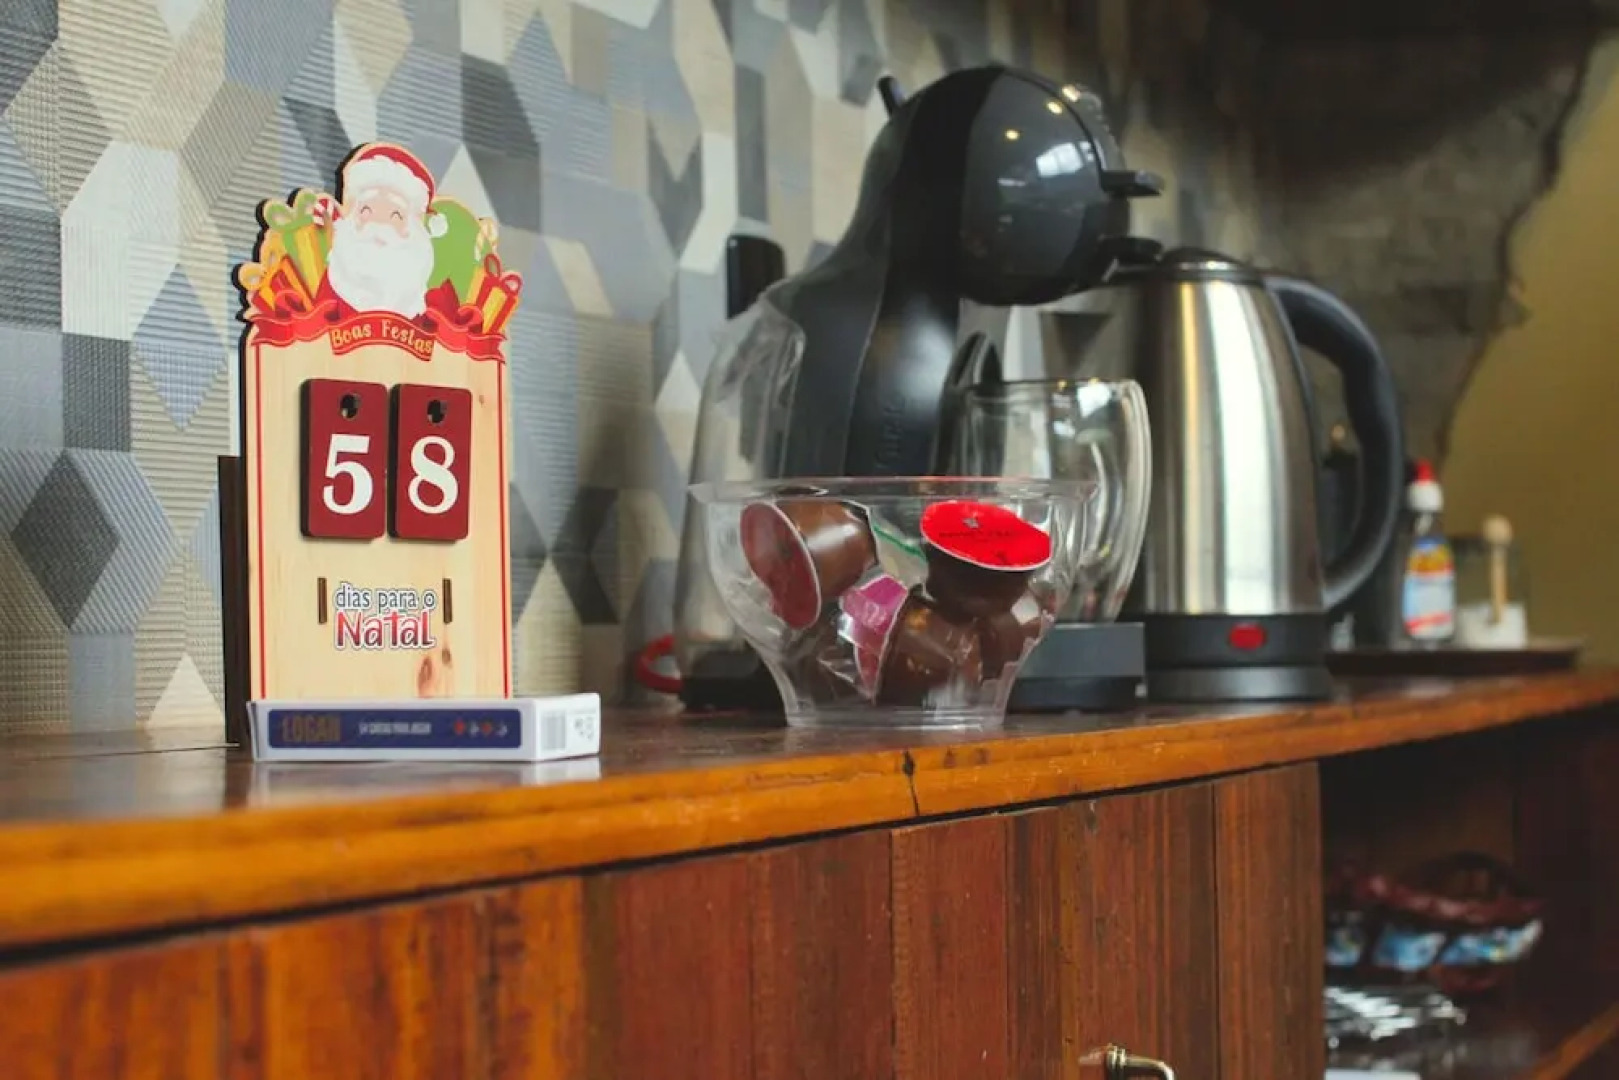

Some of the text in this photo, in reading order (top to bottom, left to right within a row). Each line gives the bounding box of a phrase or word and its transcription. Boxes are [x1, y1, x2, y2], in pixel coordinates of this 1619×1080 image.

[331, 319, 434, 353] Boas Festas
[335, 583, 436, 614] dias para o
[336, 610, 434, 647] Natal
